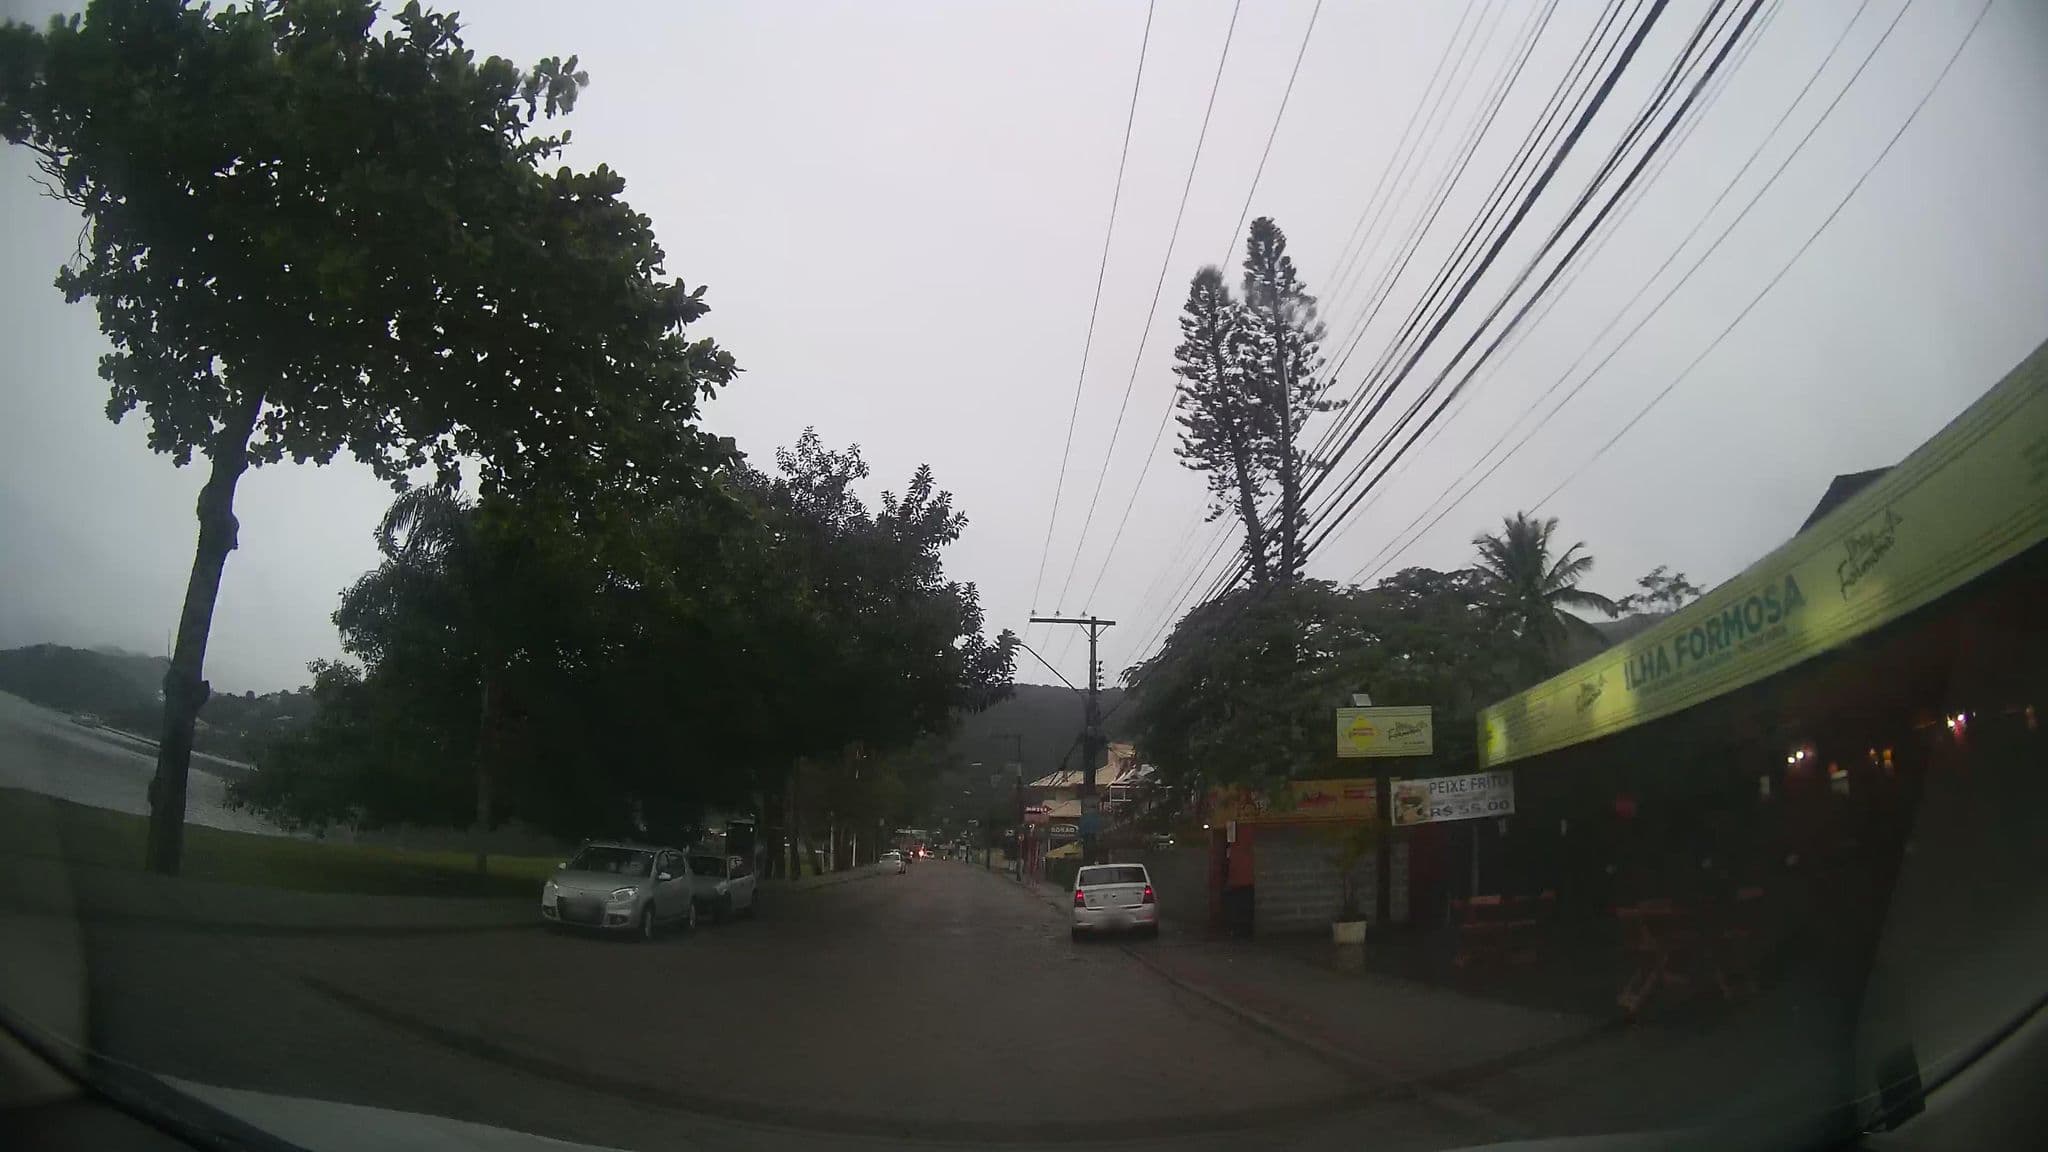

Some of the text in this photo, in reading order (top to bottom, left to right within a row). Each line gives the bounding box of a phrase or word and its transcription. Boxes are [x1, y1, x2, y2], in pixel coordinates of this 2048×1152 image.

[1624, 645, 1670, 691] ILHA
[1675, 574, 1806, 668] FORMOSA
[1430, 779, 1467, 794] PEIXE
